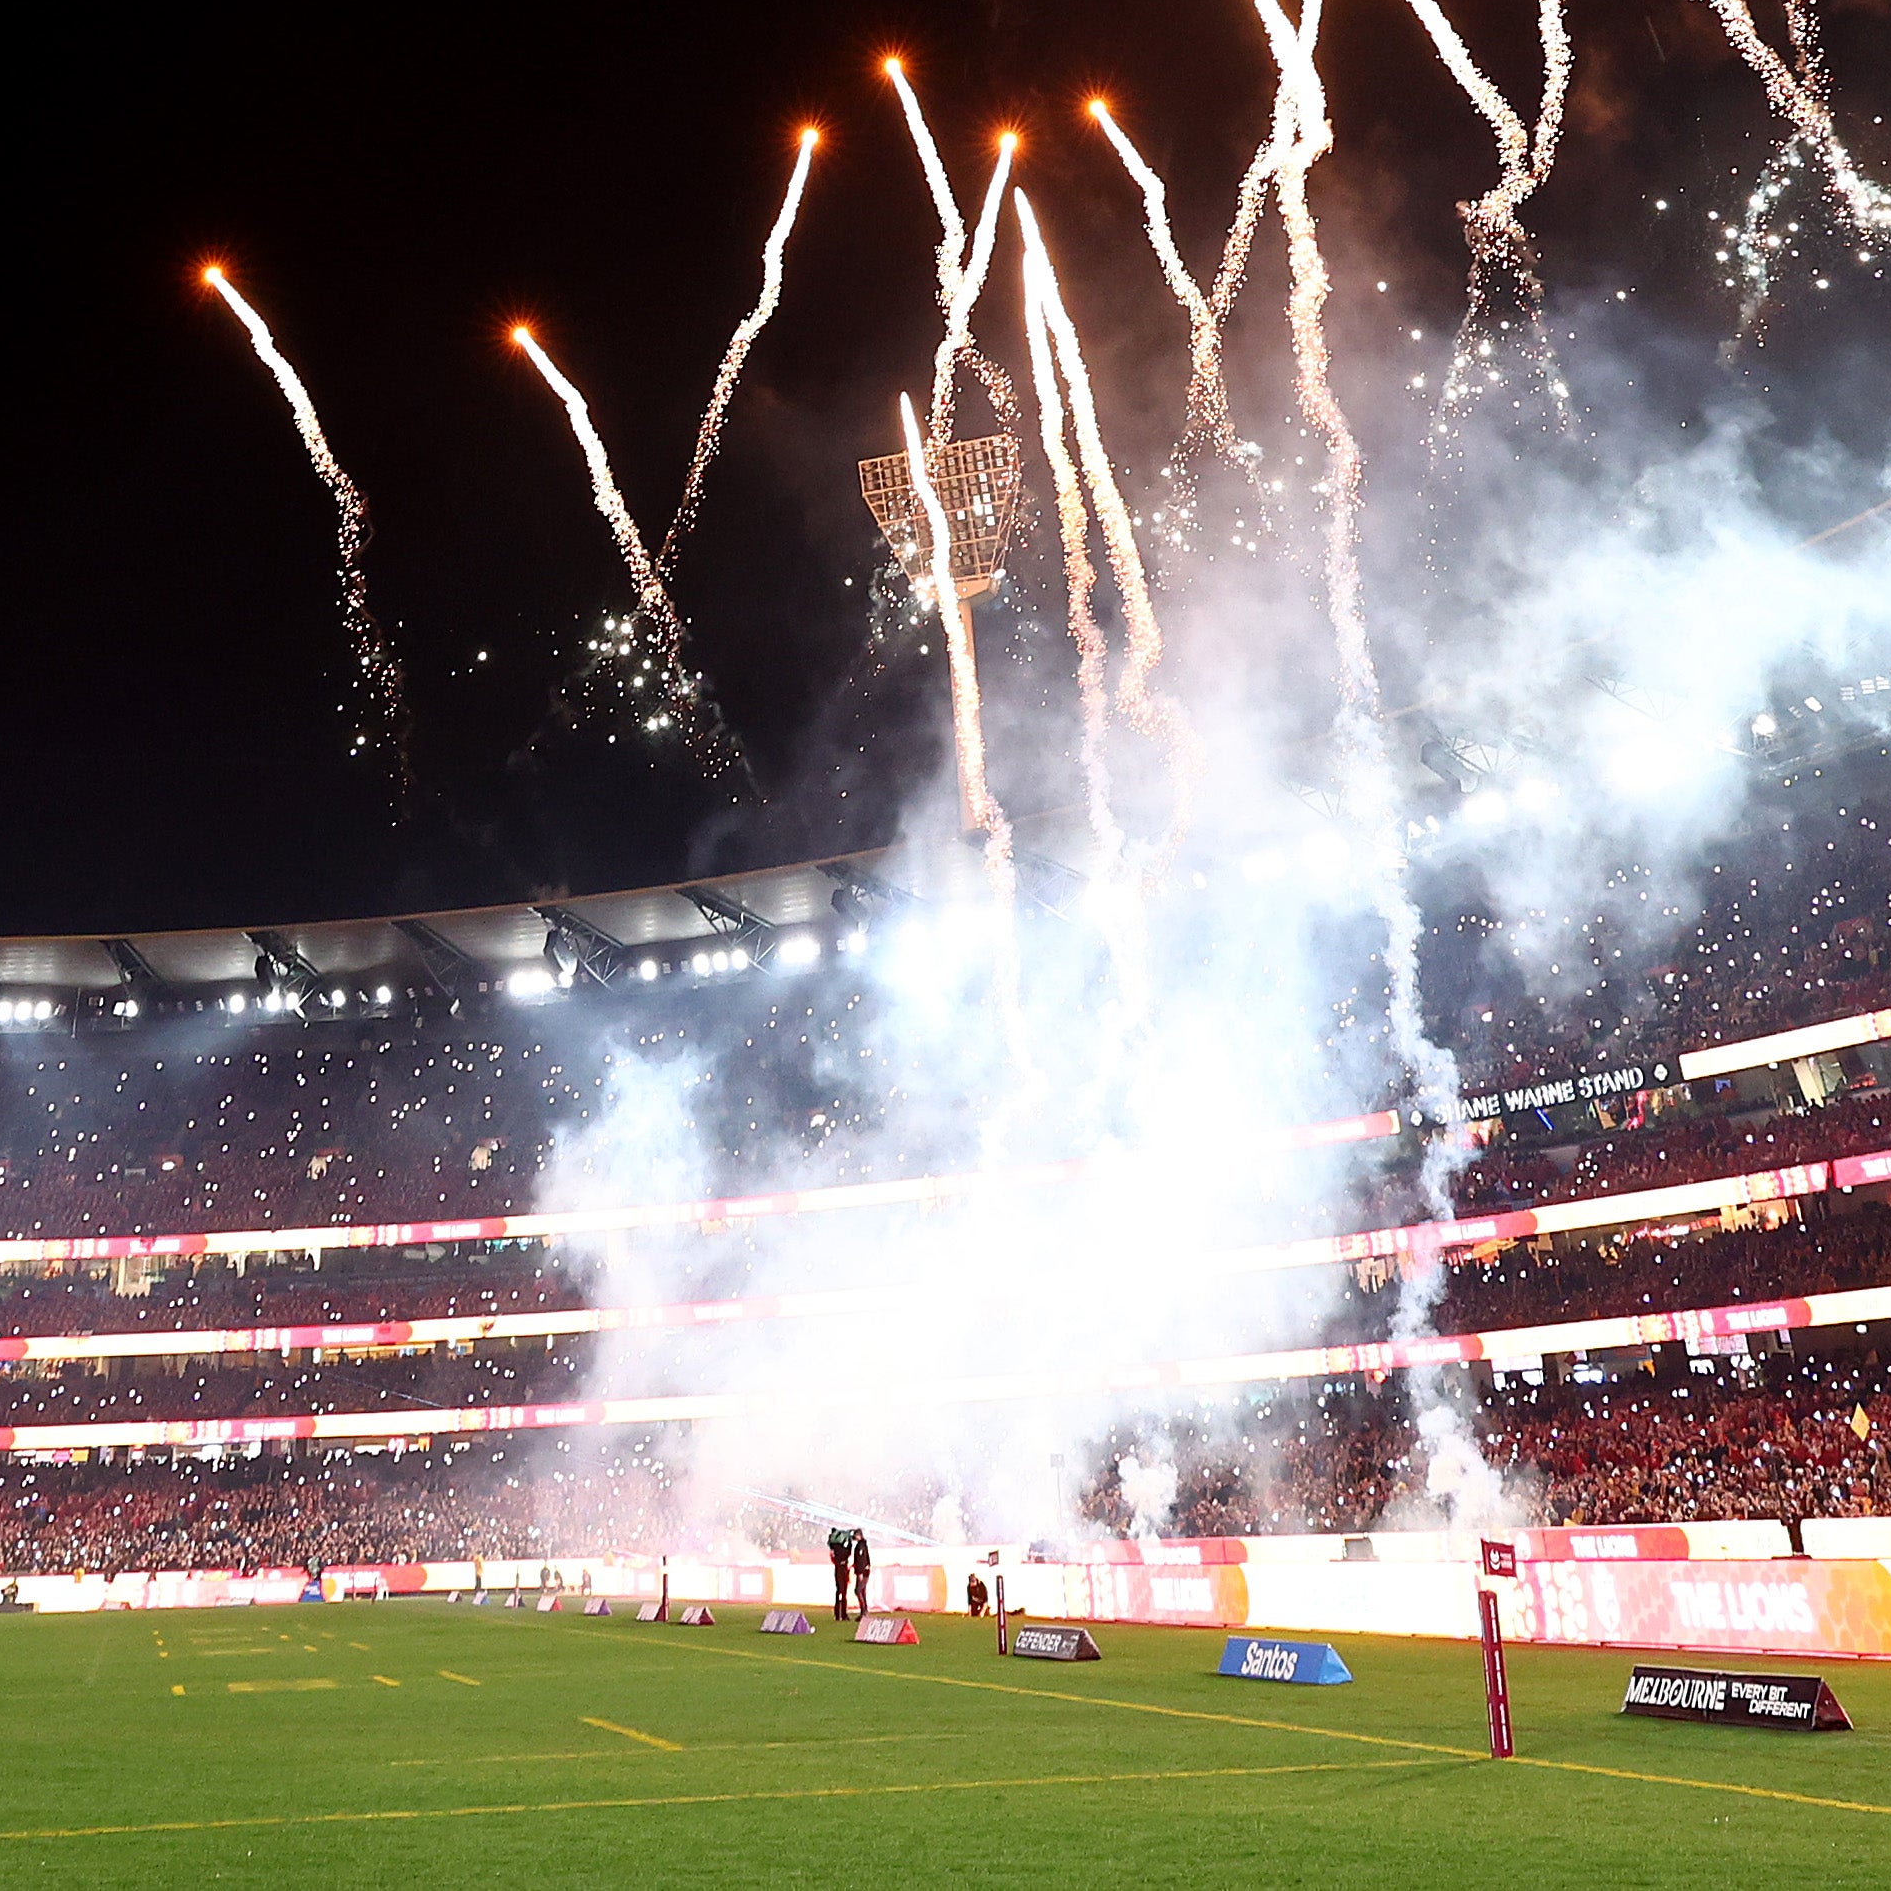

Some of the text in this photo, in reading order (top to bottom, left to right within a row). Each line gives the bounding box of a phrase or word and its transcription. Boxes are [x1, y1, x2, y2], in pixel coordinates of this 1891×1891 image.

[1435, 1067, 1644, 1125] SHANE WARNE STAND
[1596, 1535, 1638, 1558] LIONS
[1670, 1581, 1814, 1633] THE LIONS
[1241, 1641, 1298, 1680] Santos
[1625, 1676, 1727, 1710] MELBOURNE
[1731, 1683, 1788, 1701] EVERY BIT
[1749, 1701, 1811, 1719] DIFFERENT
